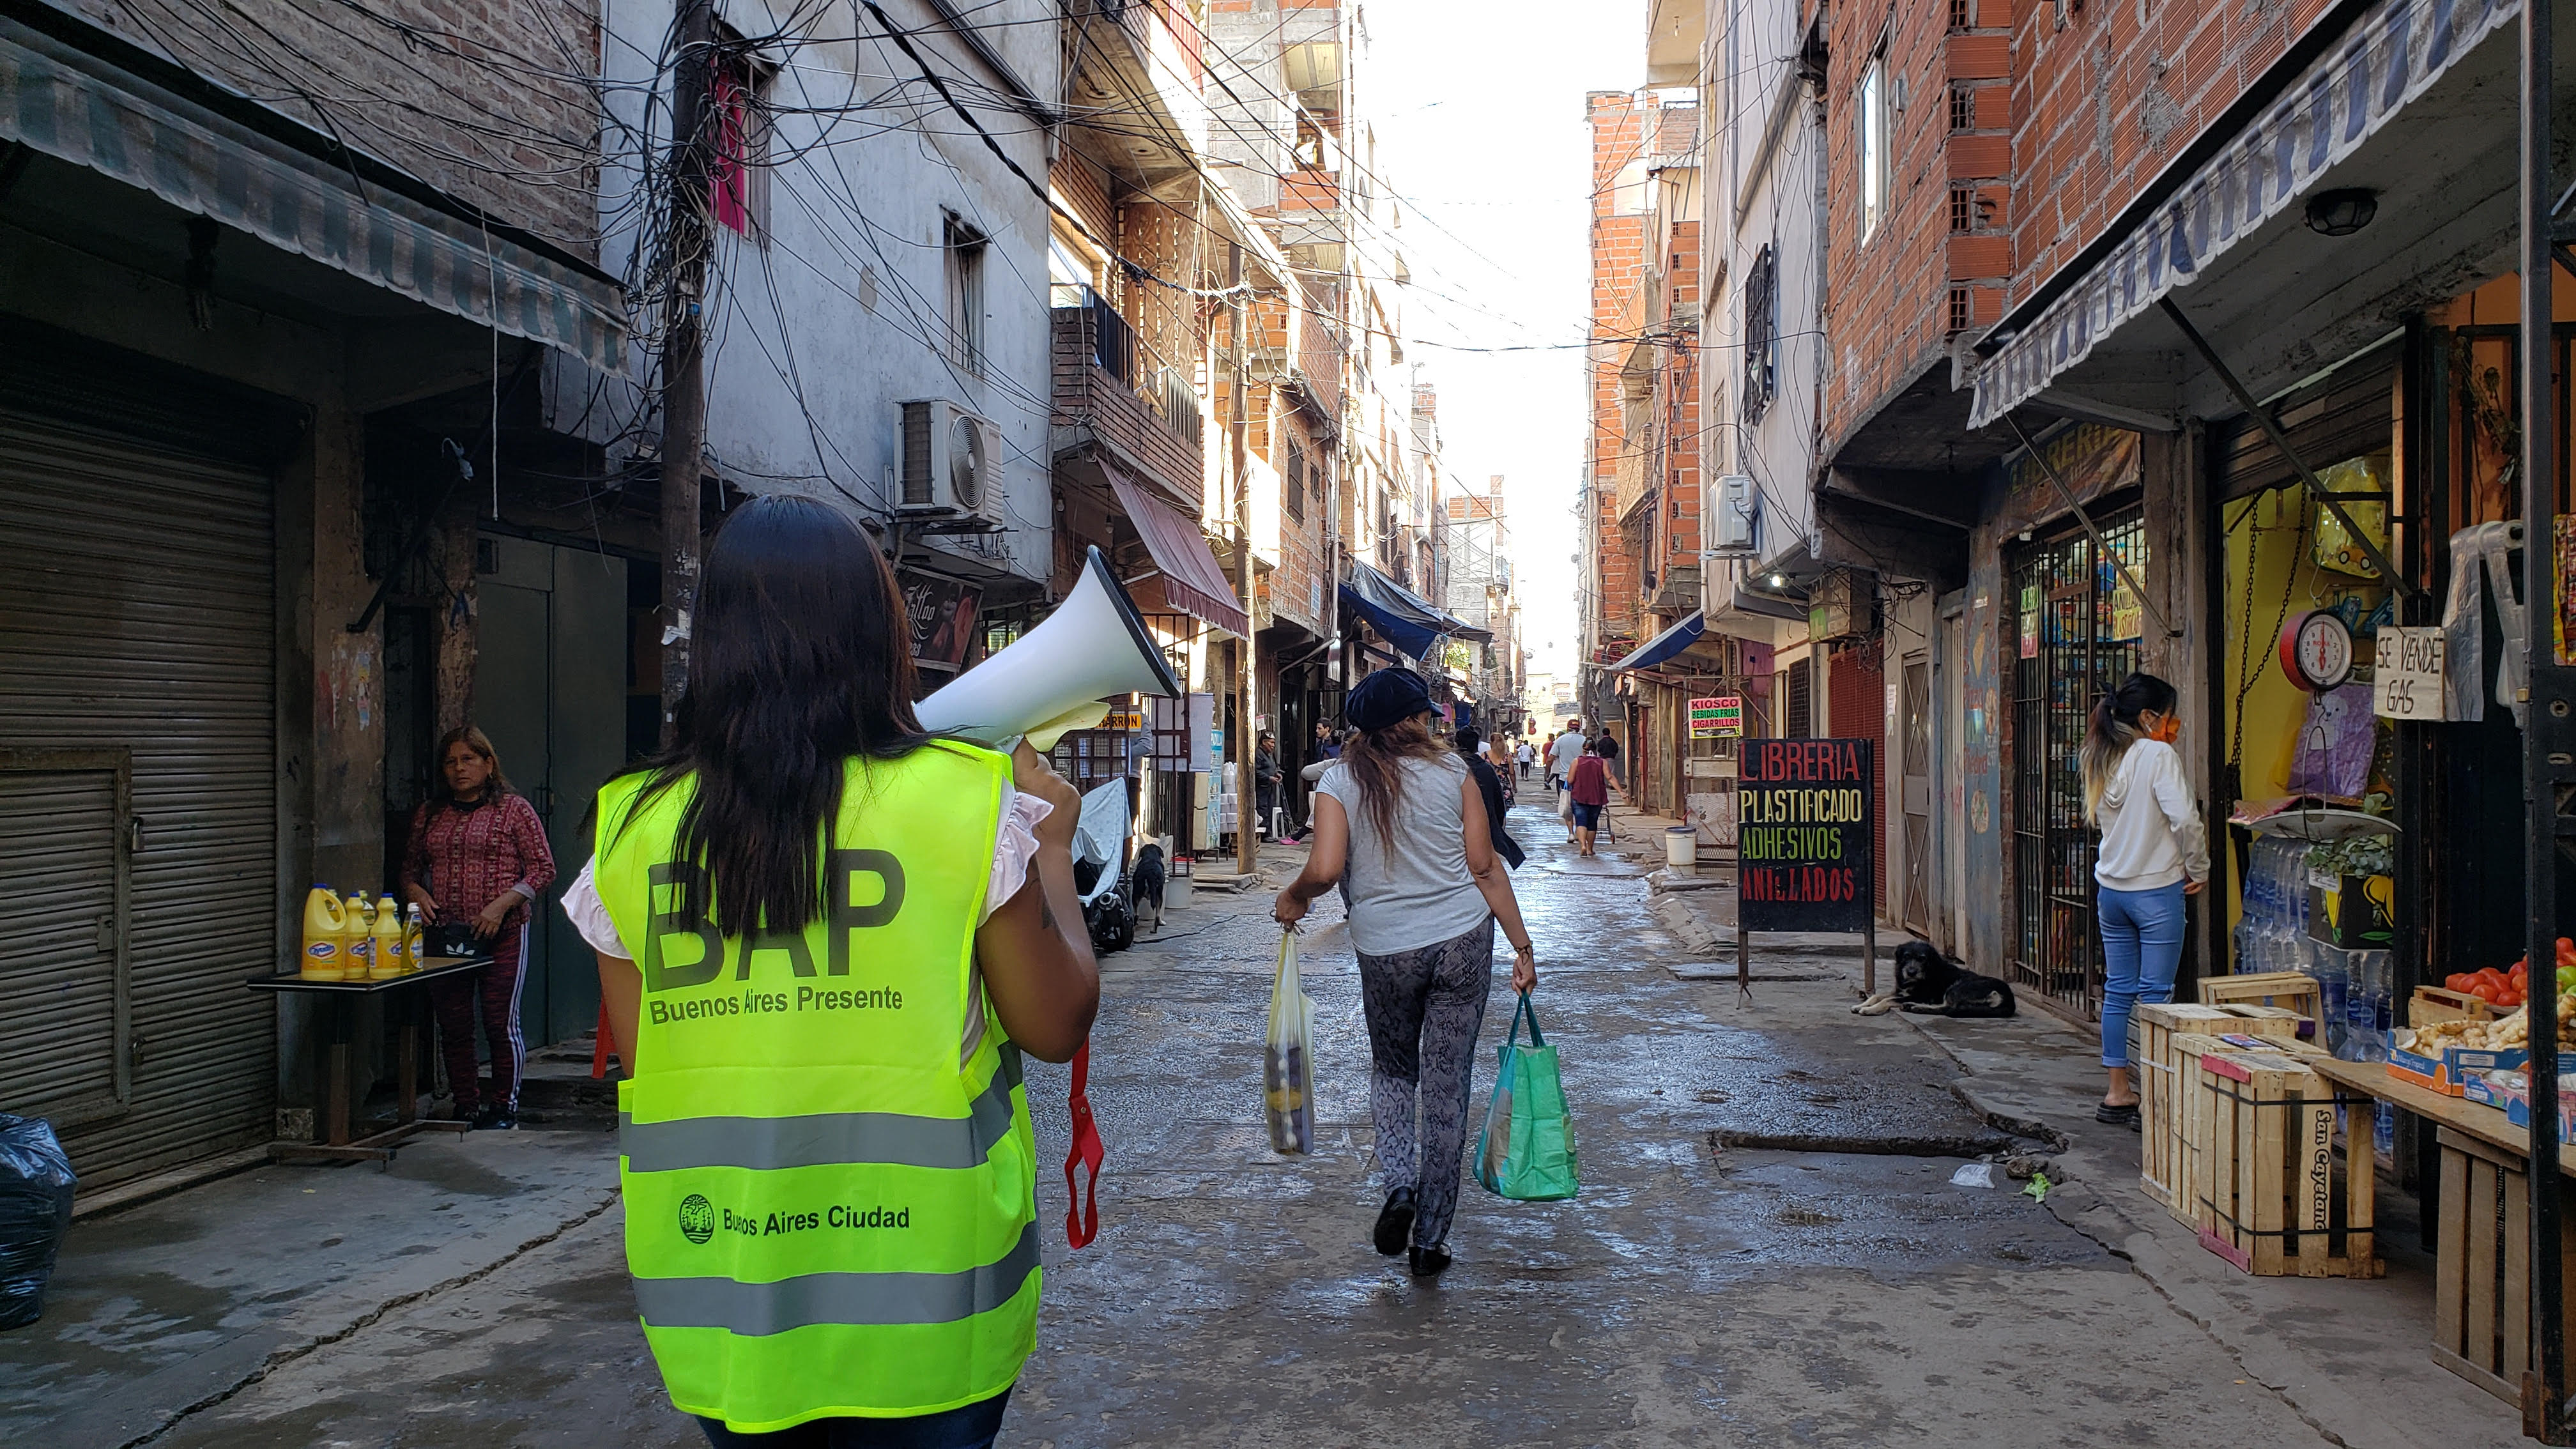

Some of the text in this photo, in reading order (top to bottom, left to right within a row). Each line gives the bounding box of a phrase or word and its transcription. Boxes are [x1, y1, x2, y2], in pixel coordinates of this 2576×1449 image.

[2378, 636, 2443, 675] SE VENDE
[1691, 699, 1738, 710] KIOSCO
[2387, 679, 2414, 714] GAS
[1692, 709, 1739, 719] BEBIDAS FRIAS
[1692, 718, 1740, 728] CIGARRILLOS
[1738, 742, 1860, 781] LIBRERIA
[1738, 789, 1862, 824] PLASTIFICADO
[1741, 827, 1841, 860] ADHESIVOS
[1742, 867, 1854, 901] ANILLADOS
[649, 986, 903, 1025] Buenos Aires Presente
[2310, 1110, 2331, 1230] San Cayetano
[763, 1211, 819, 1236] Aires
[828, 1206, 910, 1228] Ciudad
